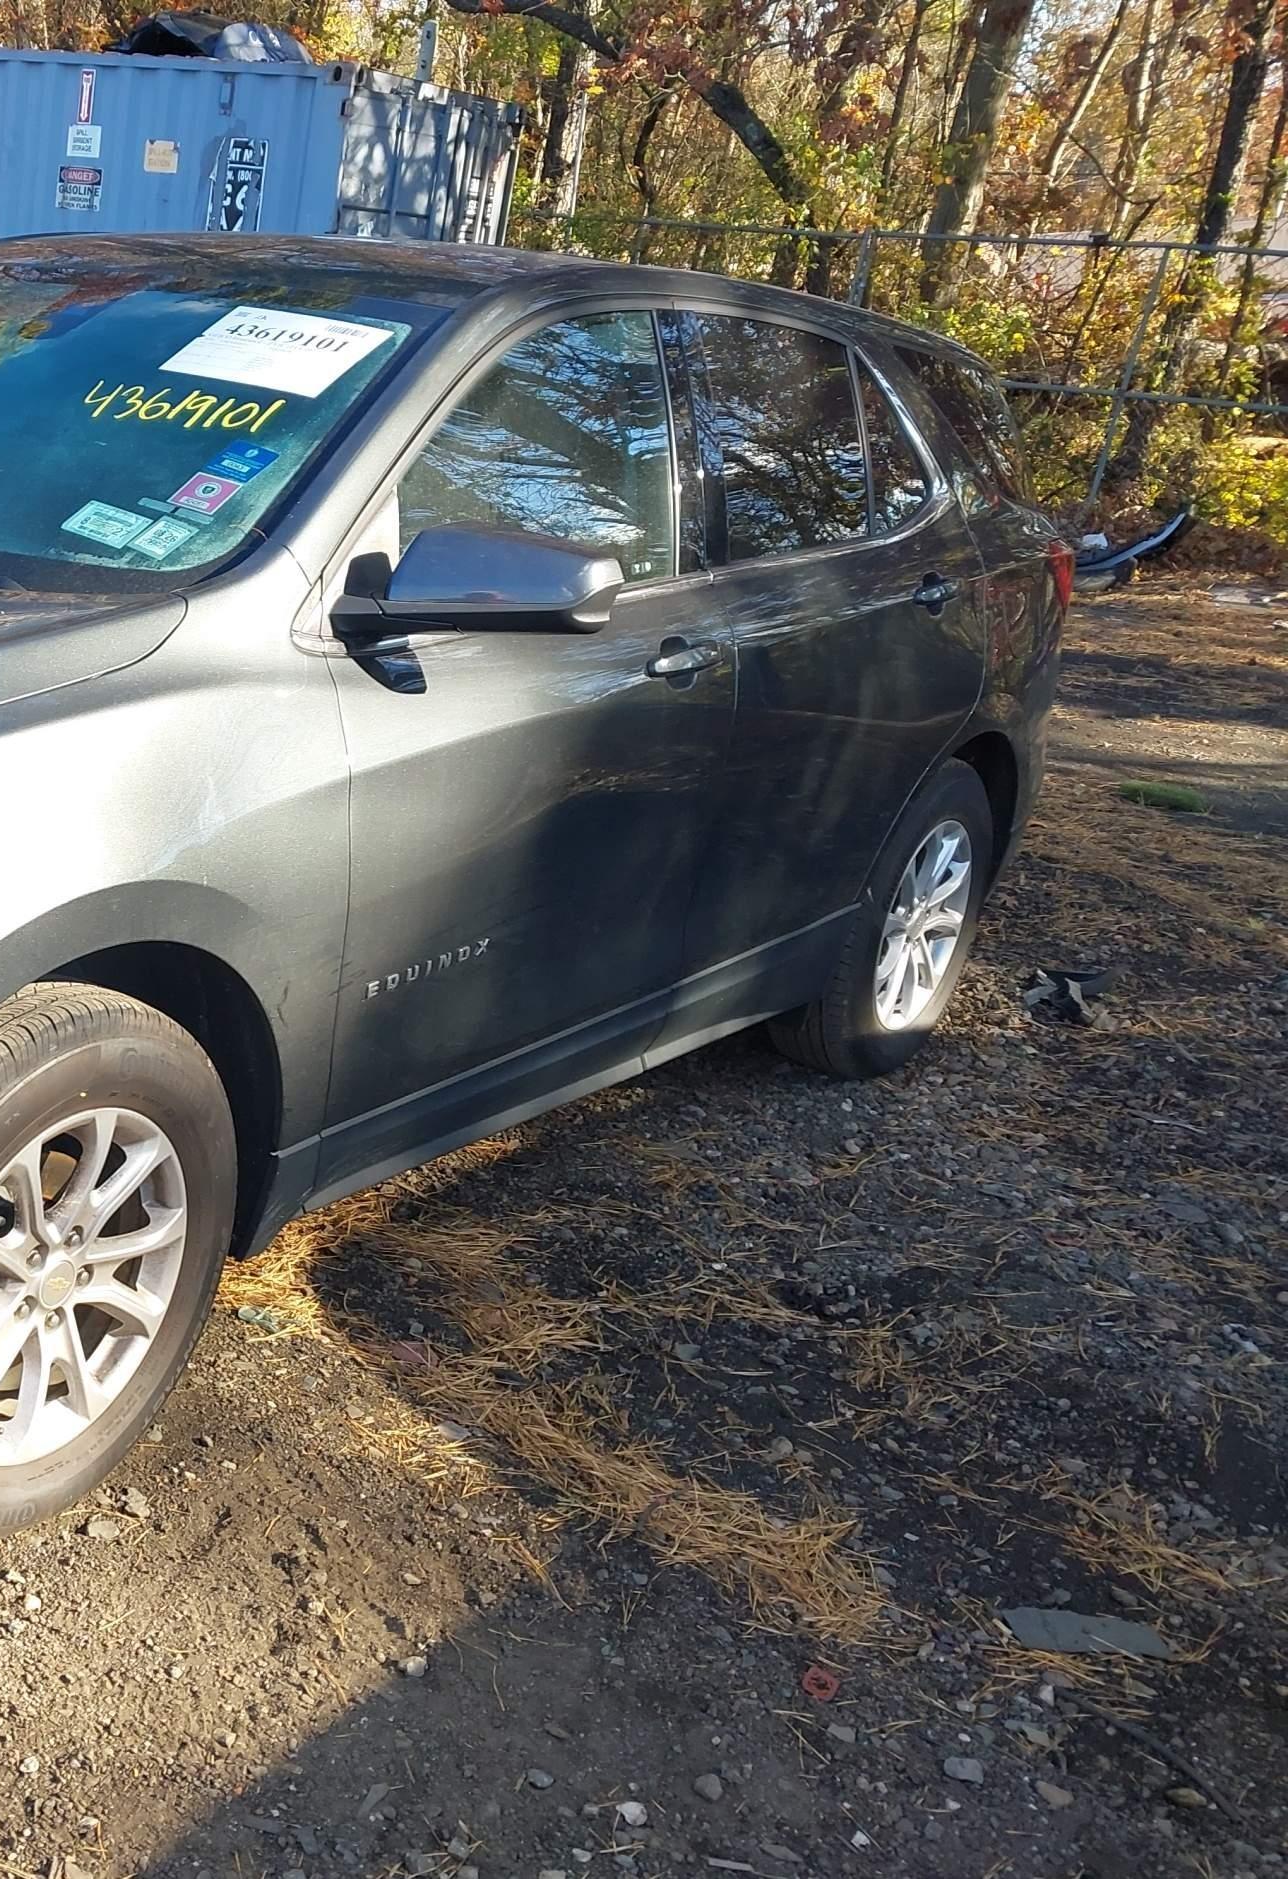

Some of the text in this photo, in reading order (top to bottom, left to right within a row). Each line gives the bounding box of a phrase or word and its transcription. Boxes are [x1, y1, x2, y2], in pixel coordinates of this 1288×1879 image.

[225, 322, 350, 353] 43619101
[84, 379, 287, 433] 43619101
[365, 938, 491, 1000] EQUINOX
